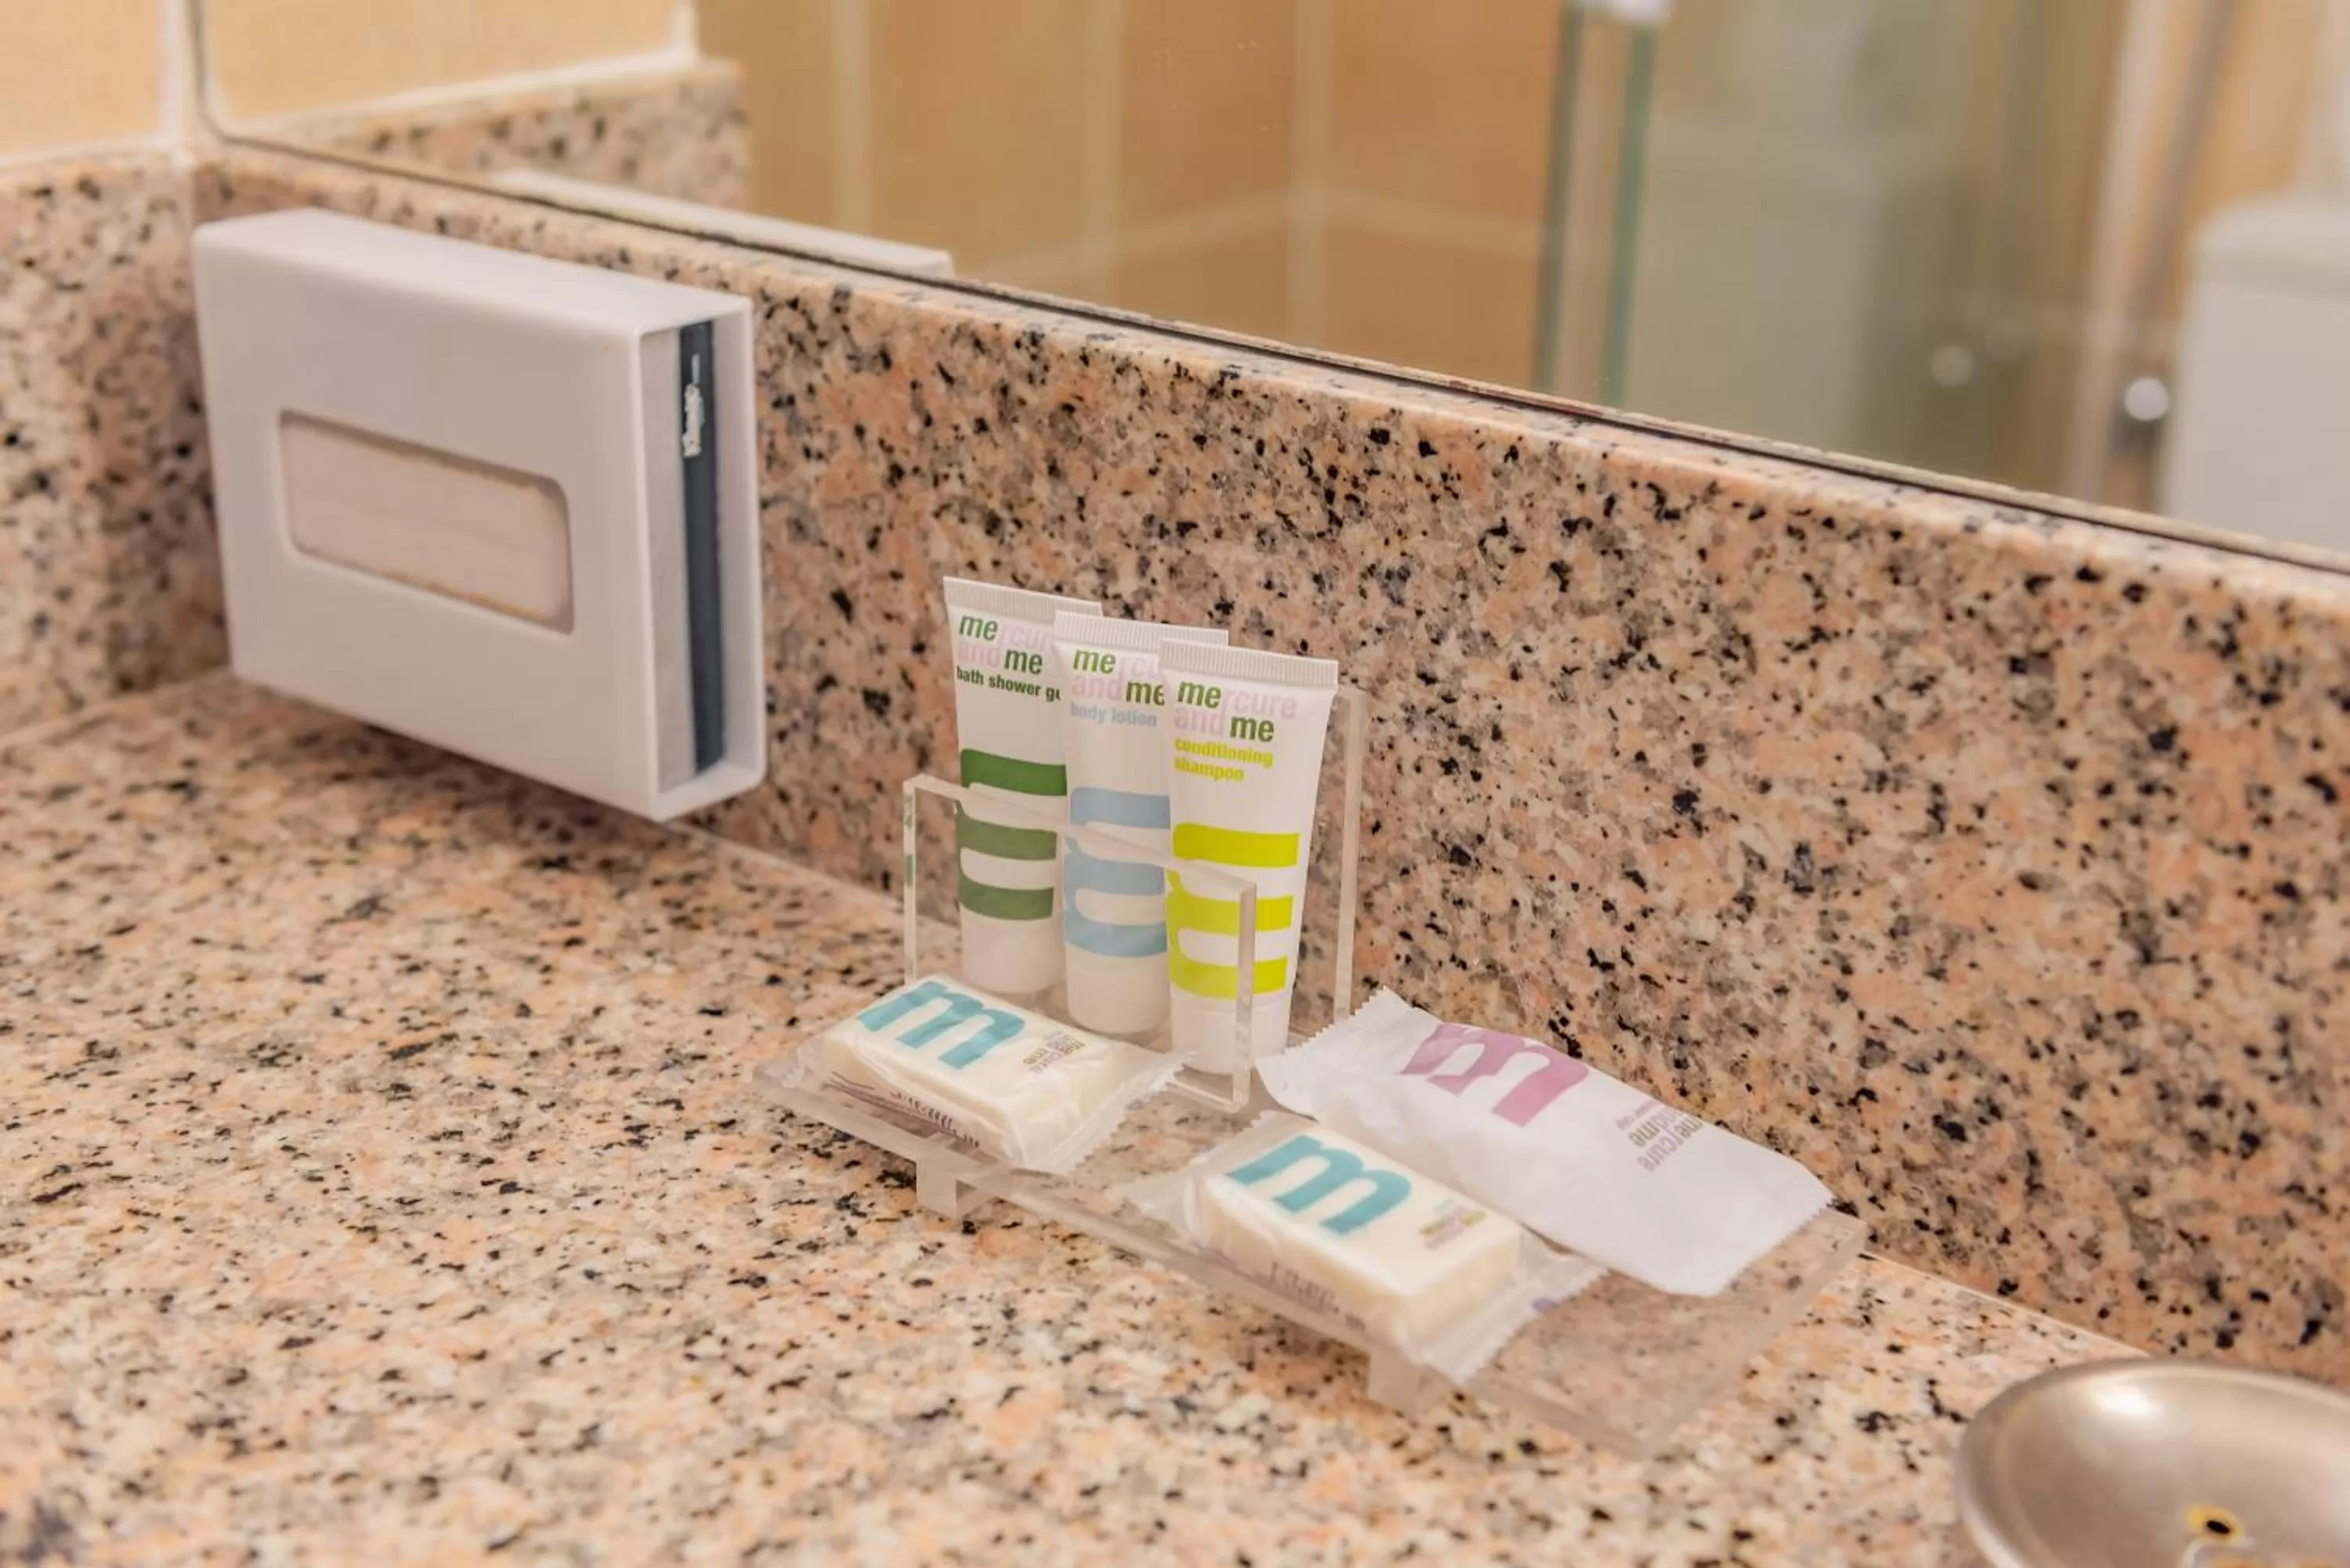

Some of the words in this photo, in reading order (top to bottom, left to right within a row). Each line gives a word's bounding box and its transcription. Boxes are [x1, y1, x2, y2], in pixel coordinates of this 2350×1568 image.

[1003, 649, 1043, 675] me
[956, 664, 985, 686] bath
[988, 674, 1042, 696] shower
[1126, 681, 1166, 706] me
[1070, 701, 1107, 724] body
[1111, 706, 1158, 728] lotion
[1177, 680, 1298, 721] mercure
[1174, 706, 1227, 735] and
[1229, 715, 1274, 742] me
[1174, 738, 1274, 768] conditioning
[1173, 757, 1245, 781] shampoo
[1223, 1133, 1413, 1236] m
